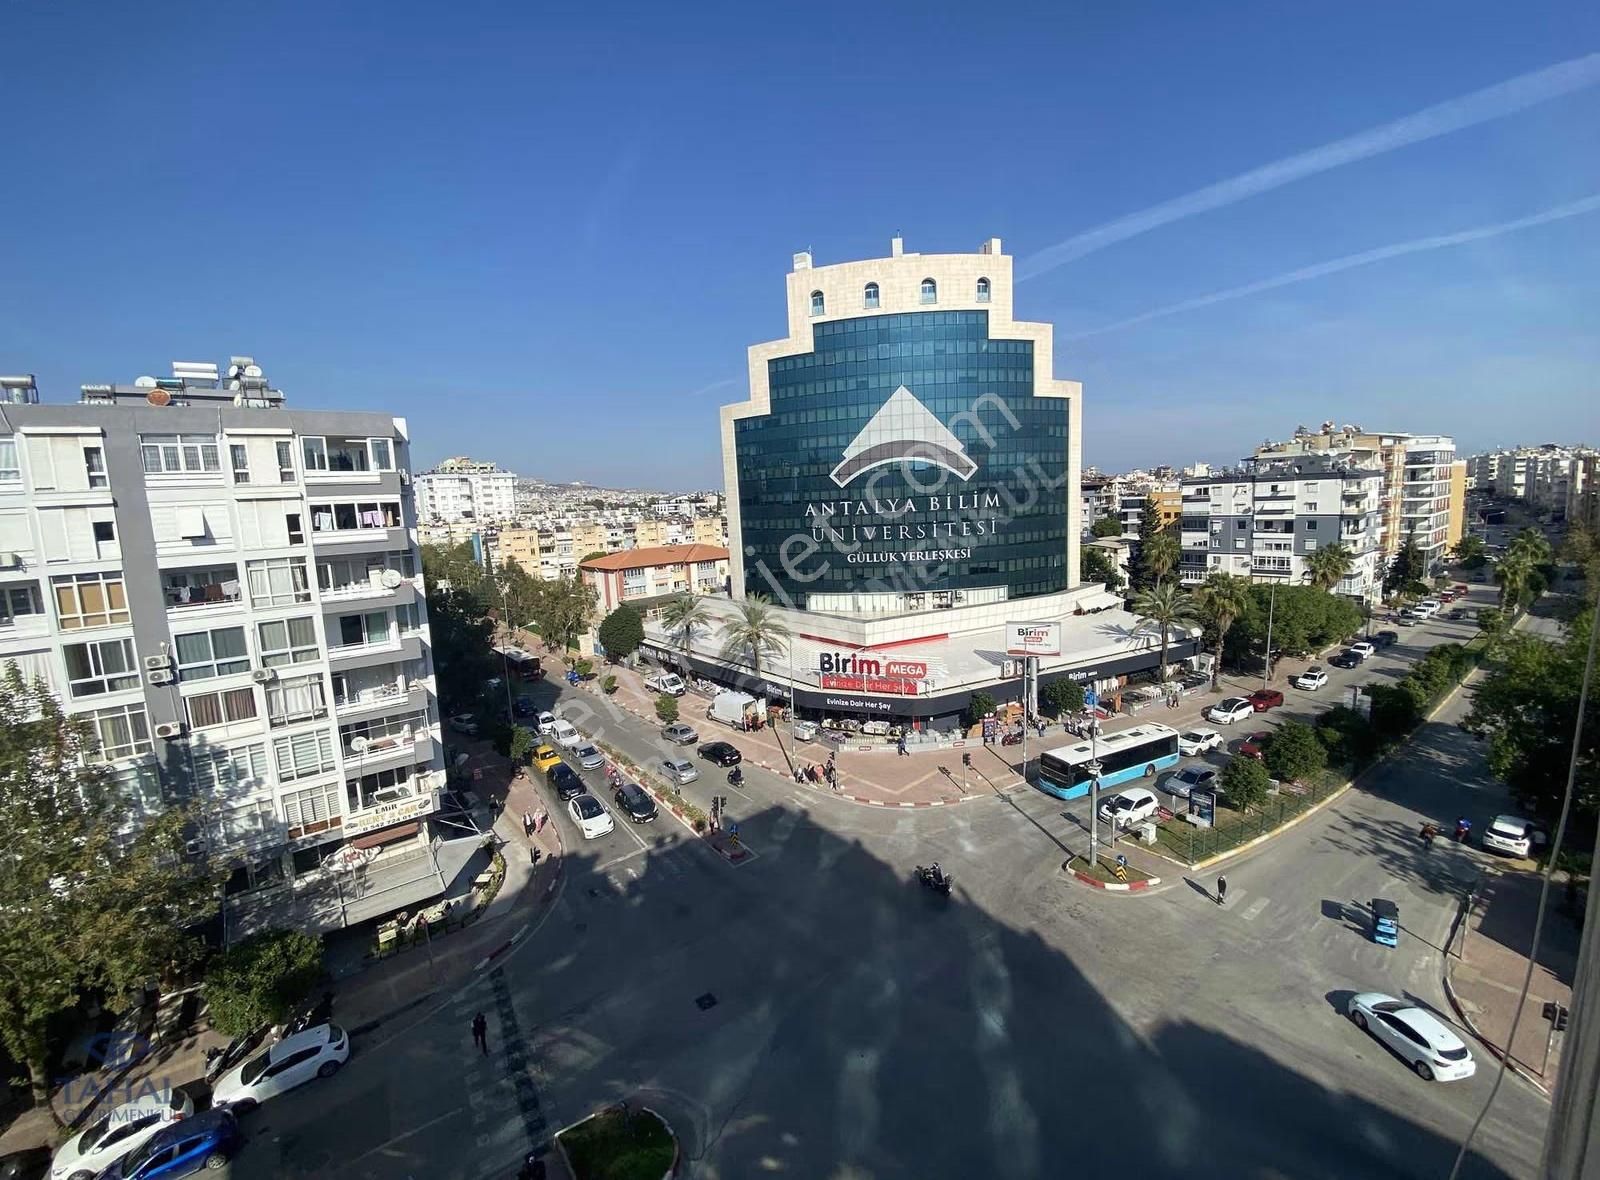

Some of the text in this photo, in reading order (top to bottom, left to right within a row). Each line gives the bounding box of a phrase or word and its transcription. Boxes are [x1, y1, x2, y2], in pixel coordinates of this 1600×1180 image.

[804, 488, 1001, 517] ANTALYA BİLİM
[811, 515, 998, 543] ÜNİVERSİTESİ
[846, 547, 971, 564] GÜLLÜK YERLEŞKESİ
[1017, 628, 1048, 637] Birim
[819, 652, 924, 676] Birim MEGA
[875, 681, 891, 690] Her
[826, 698, 849, 706] Evinize
[849, 699, 864, 707] Dair
[865, 700, 878, 708] Her
